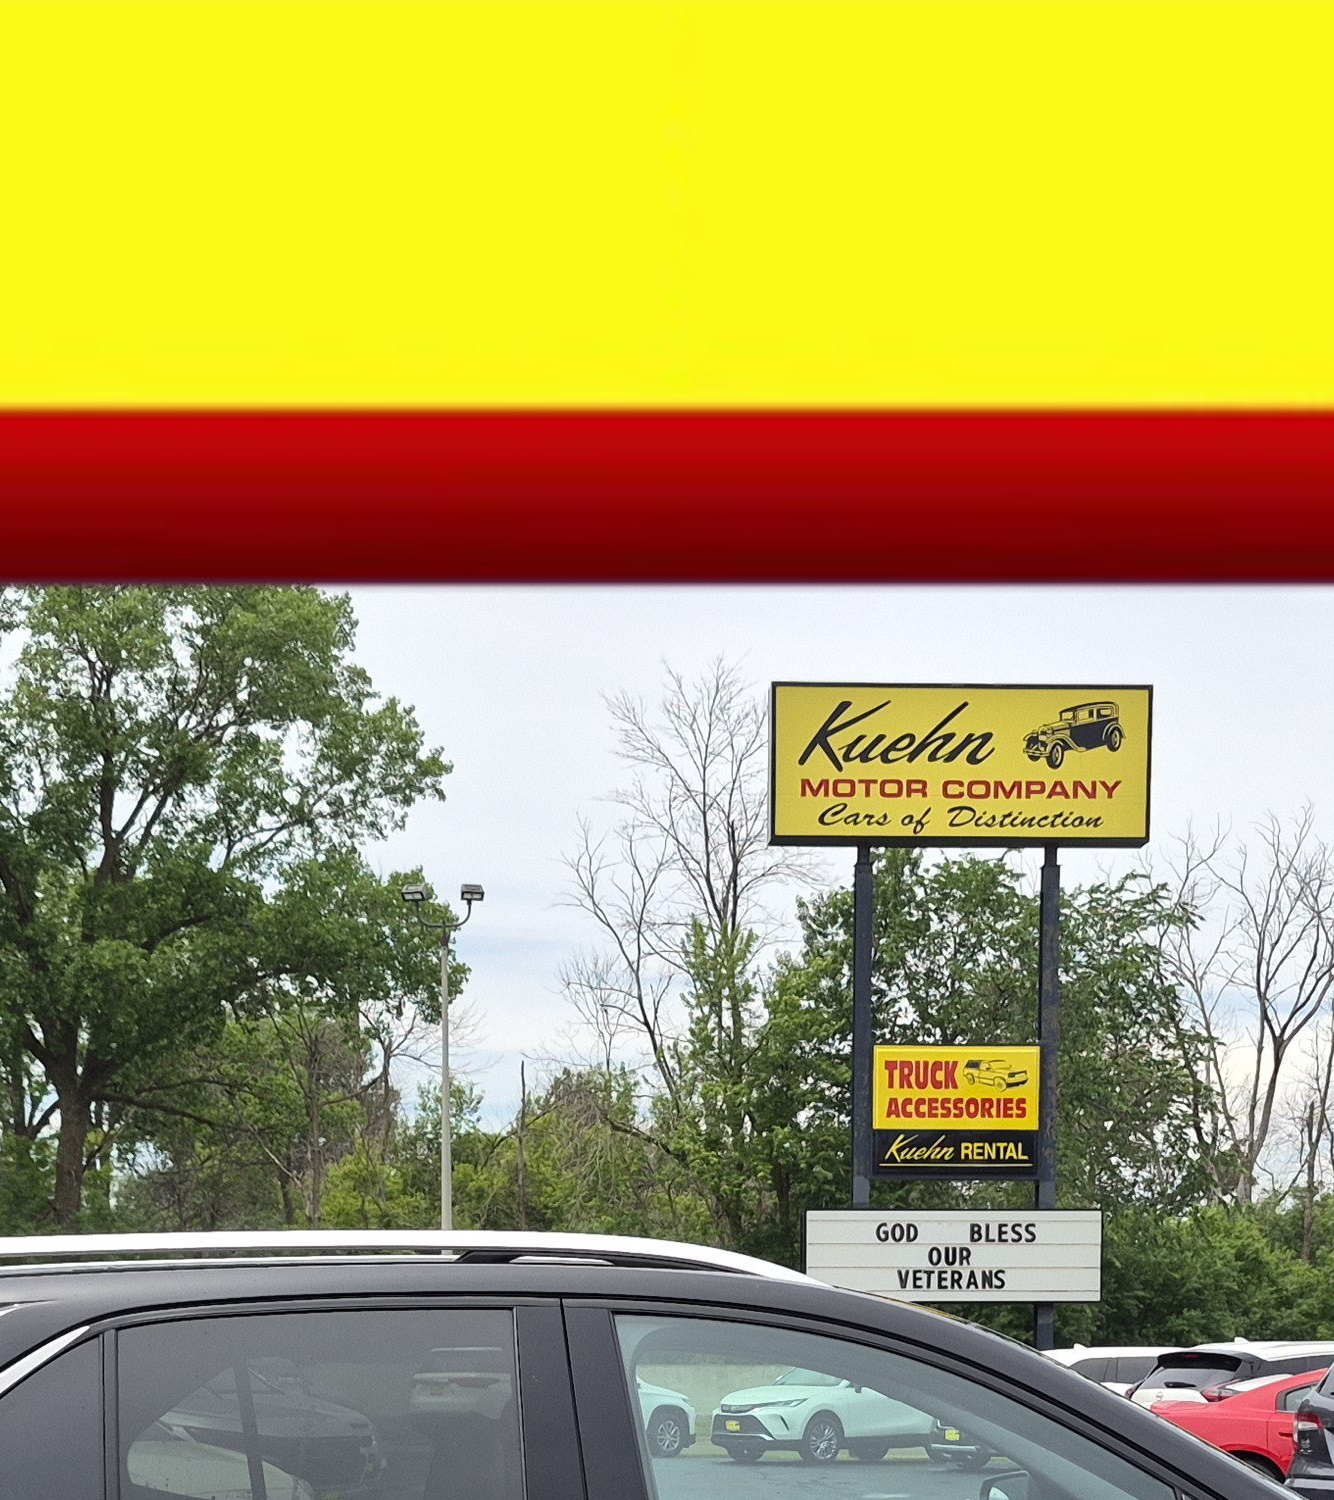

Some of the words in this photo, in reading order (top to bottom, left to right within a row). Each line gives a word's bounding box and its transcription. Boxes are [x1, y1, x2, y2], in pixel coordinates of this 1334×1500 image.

[798, 699, 996, 773] Kuehn
[800, 778, 928, 799] MOTOR
[941, 780, 1122, 801] COMPANY
[817, 802, 892, 827] Cars
[900, 806, 933, 835] of
[947, 804, 1104, 829] Distinction
[884, 1060, 959, 1091] TRUCK
[885, 1097, 1028, 1119] ACCESSORIES
[884, 1134, 955, 1162] Kuehn
[960, 1142, 1029, 1161] RENTAL
[875, 1222, 919, 1243] GOD
[969, 1222, 1037, 1243] BLESS
[927, 1246, 972, 1267] OUR
[896, 1269, 1006, 1290] VETERANS
